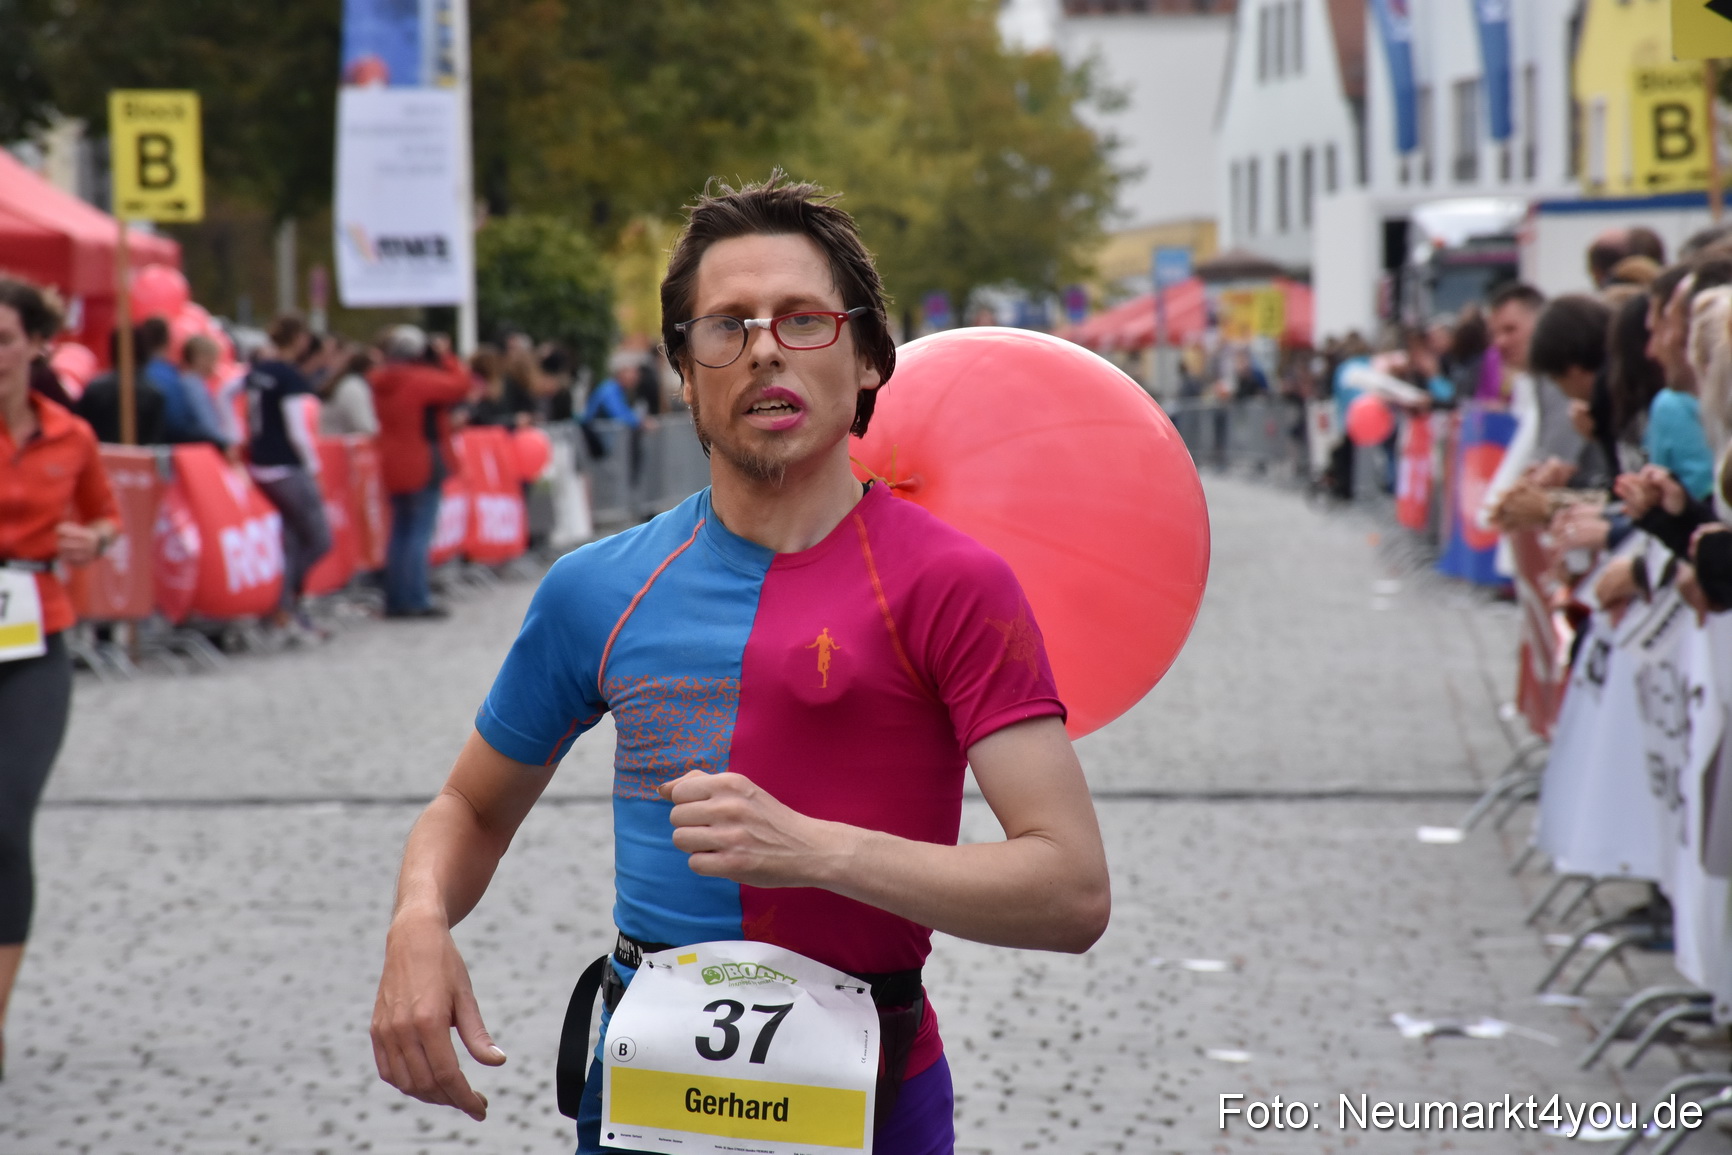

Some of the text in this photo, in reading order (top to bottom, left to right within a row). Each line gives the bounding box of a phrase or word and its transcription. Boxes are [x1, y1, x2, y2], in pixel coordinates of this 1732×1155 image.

[1653, 102, 1697, 161] B
[137, 133, 176, 190] B
[618, 1042, 628, 1056] B
[695, 999, 795, 1065] 37
[684, 1087, 789, 1122] Gerhard
